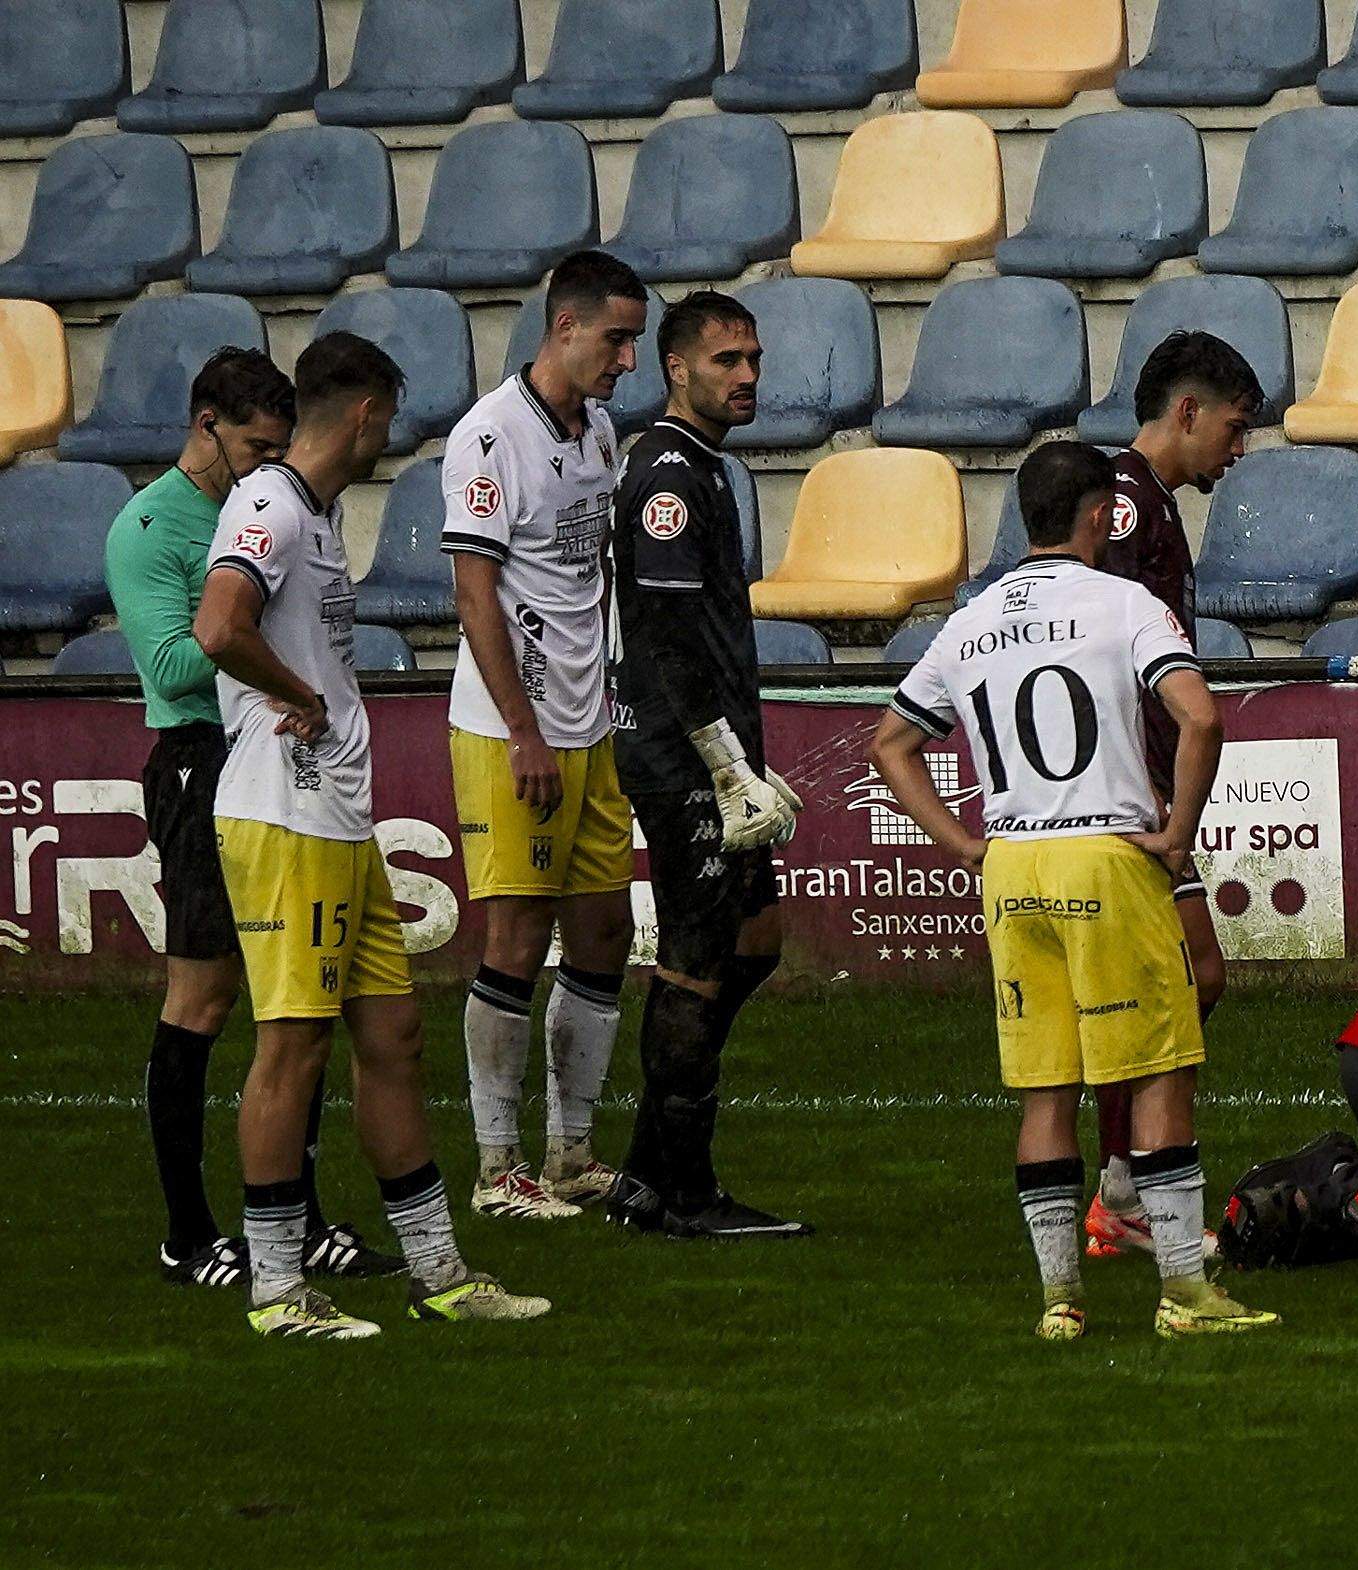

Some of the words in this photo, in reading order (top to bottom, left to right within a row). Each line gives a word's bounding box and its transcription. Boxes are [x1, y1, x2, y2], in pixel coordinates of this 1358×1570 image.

[960, 619, 1086, 661] DONCEL
[967, 664, 1098, 796] 10
[1227, 780, 1310, 803] NUEVO
[1249, 823, 1319, 858] spa
[311, 901, 349, 947] 15
[851, 908, 986, 935] Sanxenxo
